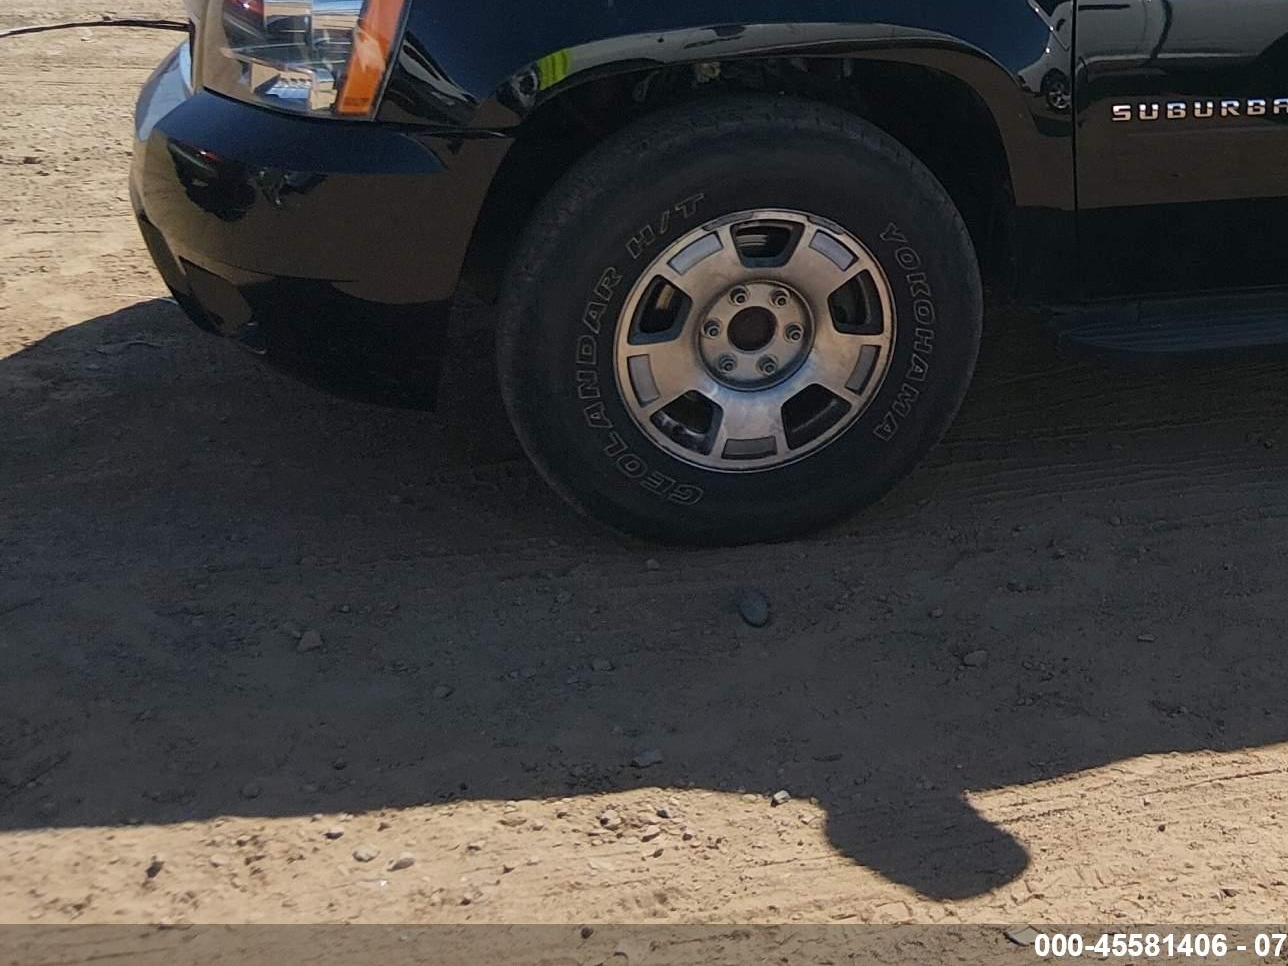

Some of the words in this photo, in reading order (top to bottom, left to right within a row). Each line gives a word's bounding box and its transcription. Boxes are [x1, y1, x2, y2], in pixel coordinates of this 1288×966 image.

[625, 192, 705, 260] H/T
[873, 221, 937, 443] YOKOHAMA
[575, 266, 704, 506] GEOLANDAR
